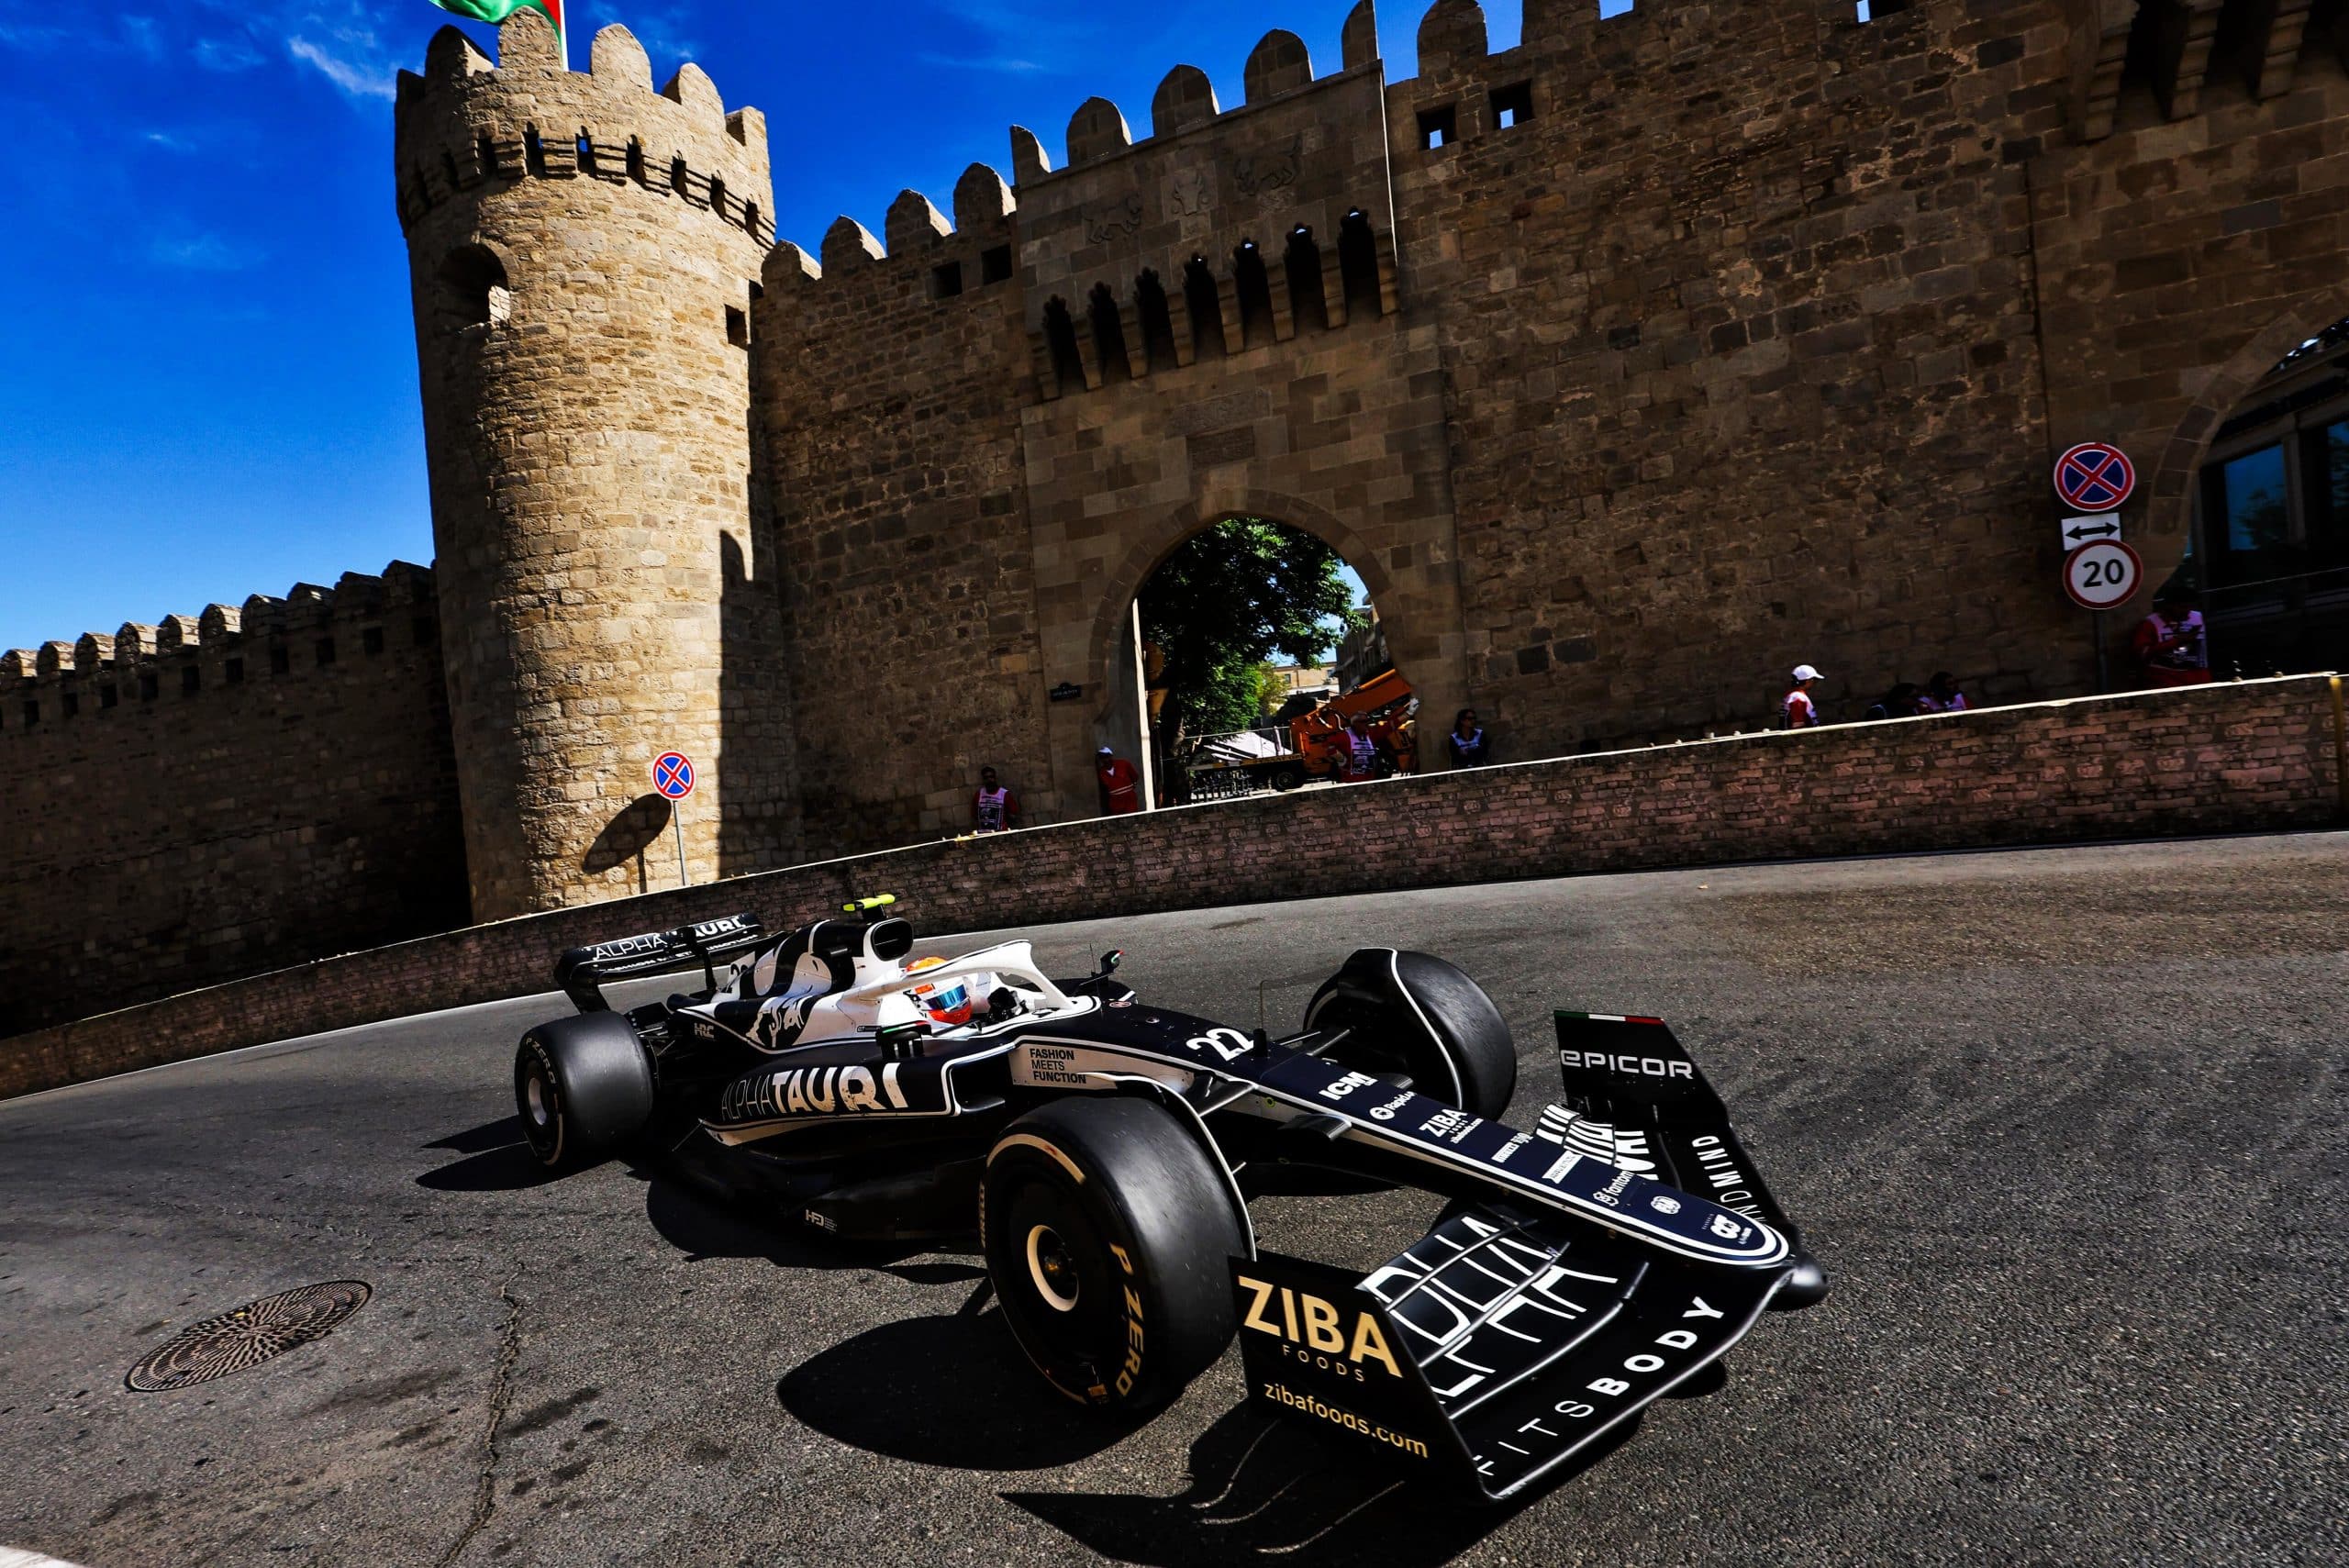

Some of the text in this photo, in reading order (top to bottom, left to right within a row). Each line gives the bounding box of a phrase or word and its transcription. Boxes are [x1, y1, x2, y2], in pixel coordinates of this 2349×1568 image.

[2083, 559, 2125, 588] 20
[1029, 1048, 1074, 1062] FASHION
[1186, 1028, 1255, 1062] 22
[1030, 1060, 1065, 1072] MEETS
[1033, 1071, 1087, 1084] FUNCTION
[1319, 1071, 1378, 1101] ICM
[1419, 1107, 1468, 1138] ZIBA
[1109, 1241, 1145, 1396] P ZERO
[1238, 1274, 1403, 1378] ZIBA
[1282, 1343, 1365, 1383] FOODS
[1264, 1383, 1429, 1459] zibafoods.com
